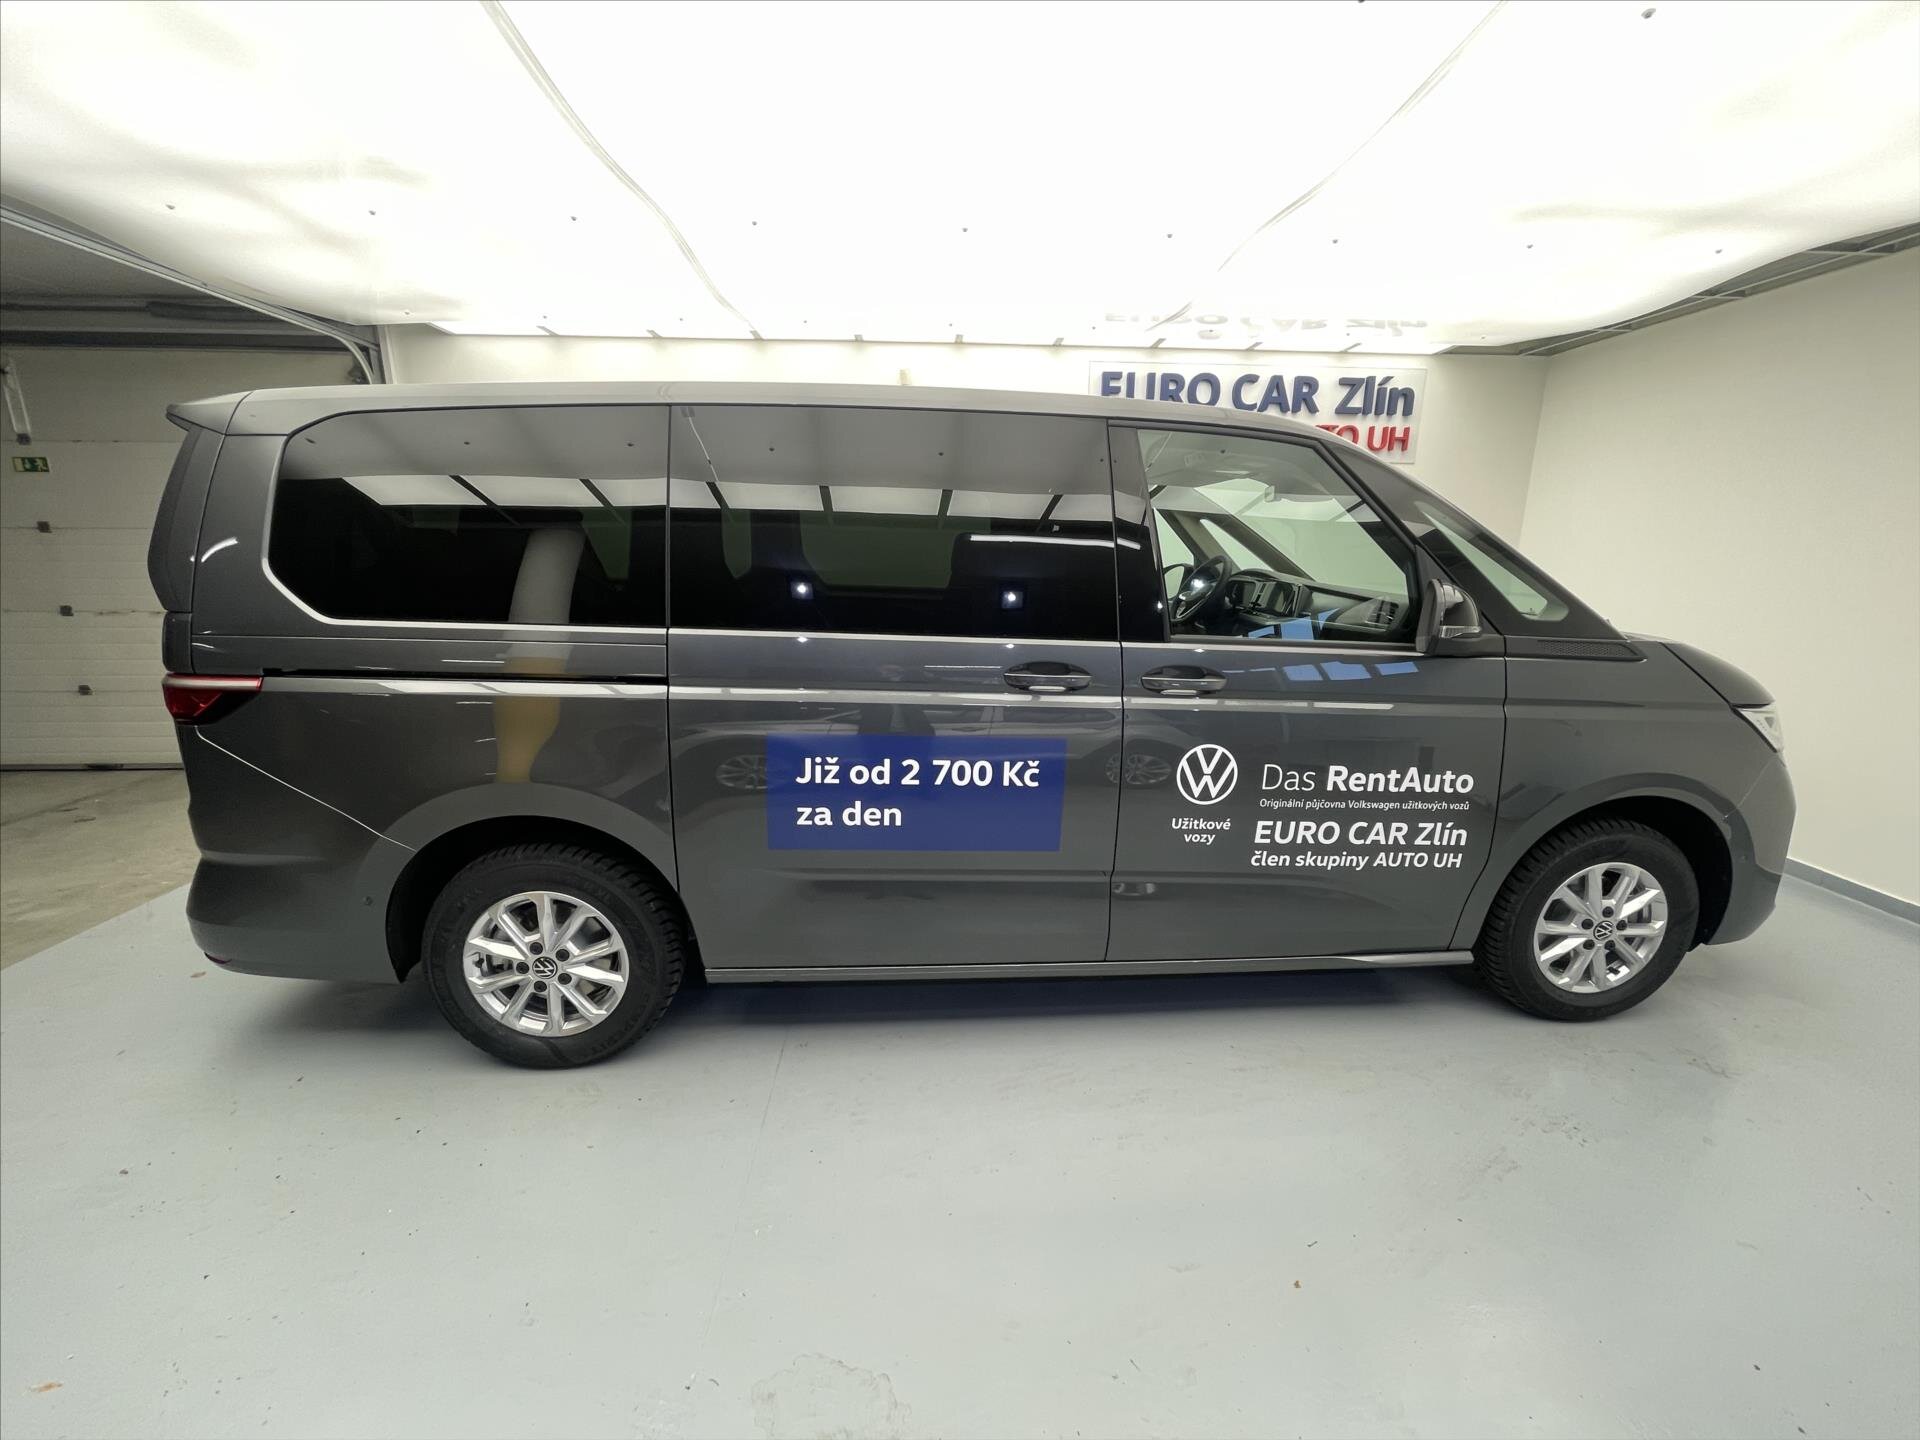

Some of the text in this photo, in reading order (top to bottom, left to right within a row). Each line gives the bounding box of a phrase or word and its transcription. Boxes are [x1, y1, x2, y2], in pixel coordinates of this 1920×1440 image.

[1231, 374, 1320, 414] CAR
[1335, 376, 1415, 416] Zlín
[1367, 425, 1410, 452] UH
[795, 756, 1041, 788] Již od 2 700 Kč
[1261, 763, 1475, 794] Das RentAuto
[796, 800, 902, 826] za den
[1259, 798, 1470, 812] Originální půjčovna Volkswagen užitkových vozů
[1171, 817, 1232, 832] Užitkové
[1253, 820, 1468, 846] EURO CAR Zlín
[1183, 833, 1216, 846] vozy
[1250, 849, 1463, 871] člen skupiny AUTO UH
